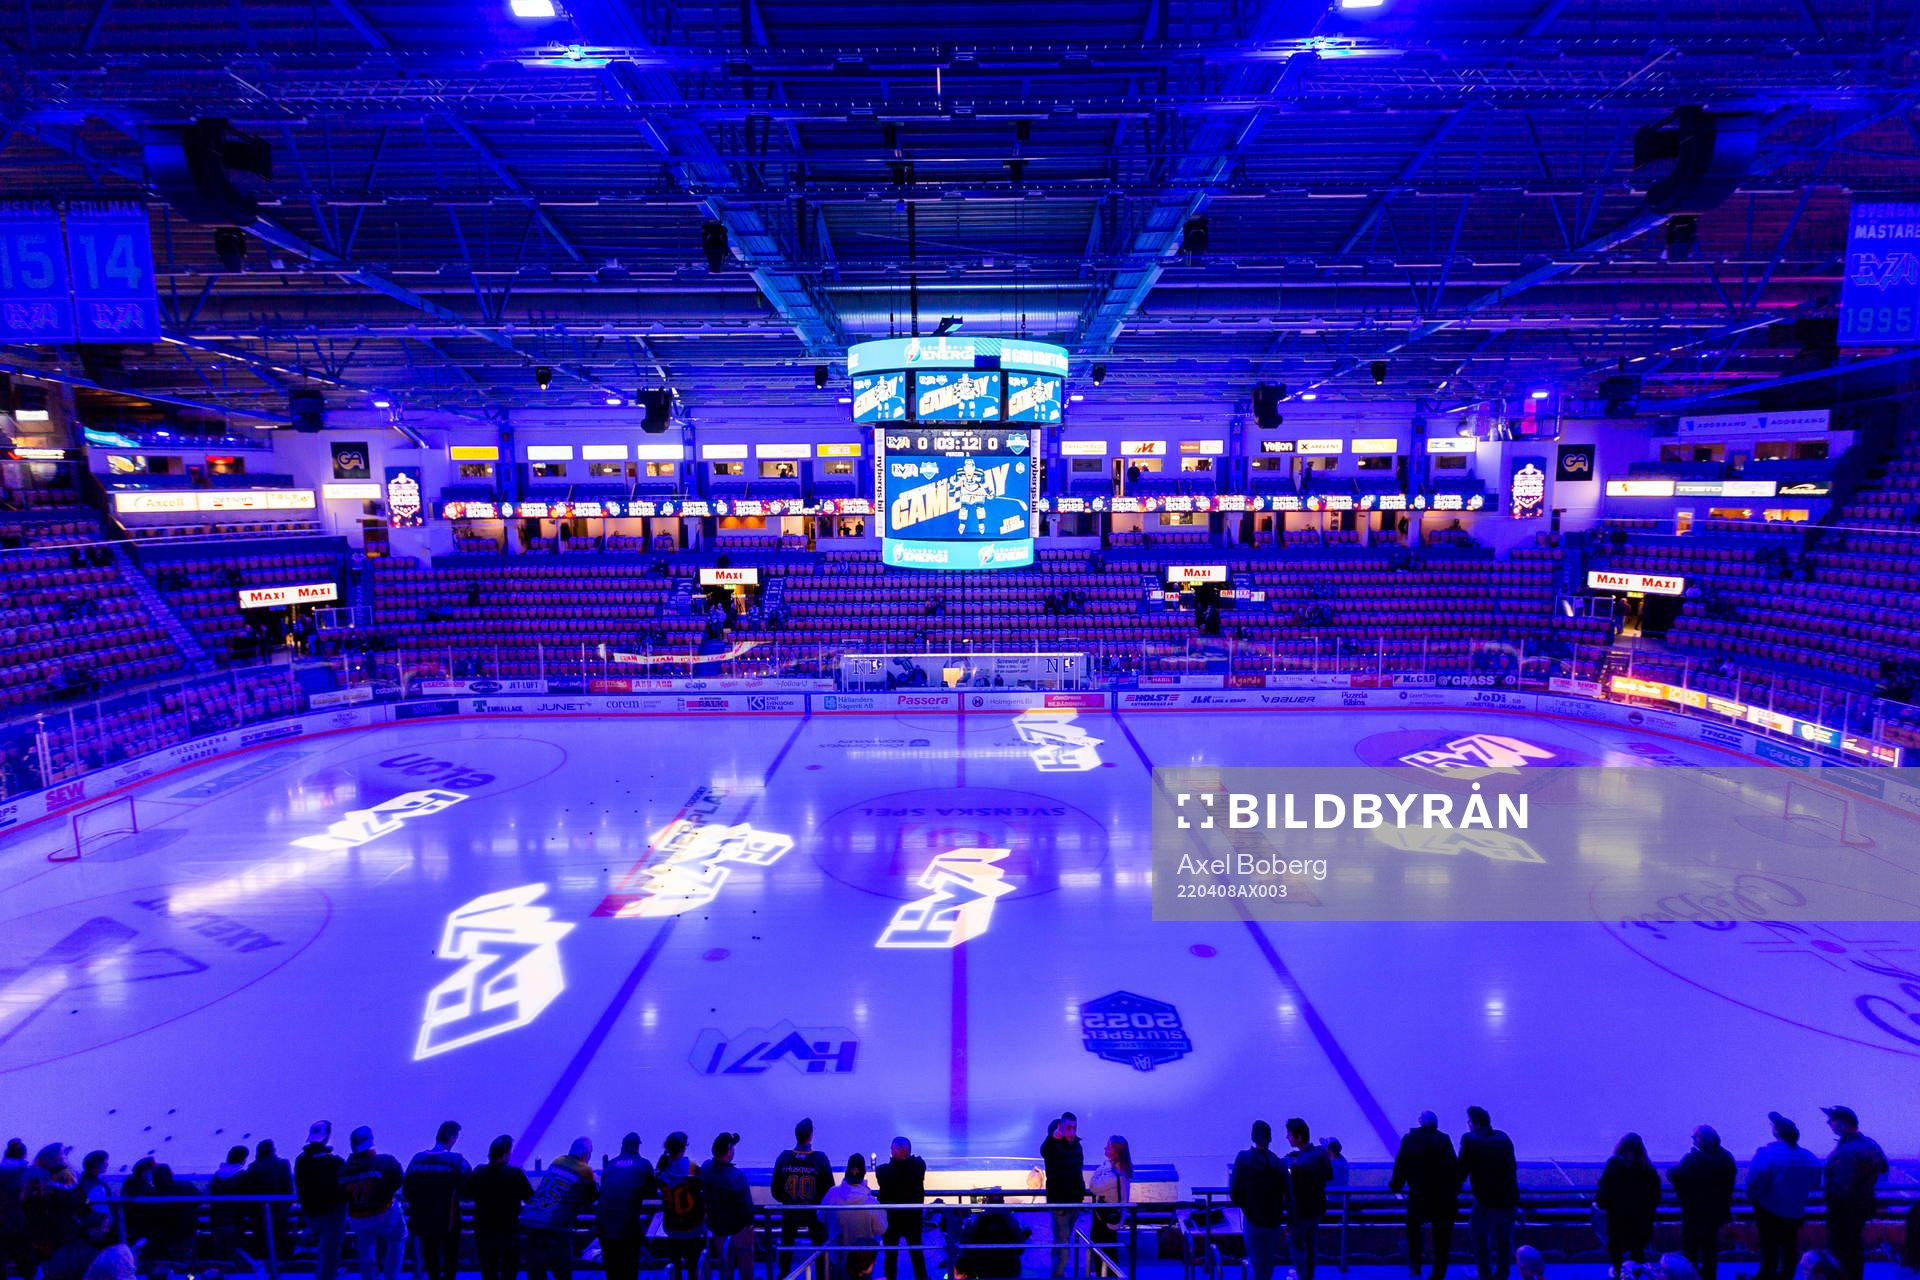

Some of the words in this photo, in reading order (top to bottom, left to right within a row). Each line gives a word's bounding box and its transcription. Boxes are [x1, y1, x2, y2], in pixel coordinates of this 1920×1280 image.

[69, 199, 142, 217] STILLMAN
[0, 234, 54, 289] 15
[79, 234, 142, 290] 14
[1847, 307, 1912, 333] 1995
[917, 438, 928, 449] 0
[937, 437, 979, 450] 03:12
[987, 438, 998, 449] 0
[891, 463, 1010, 531] GAMEAY
[1452, 675, 1495, 686] GRASS
[897, 694, 949, 706] Passera
[1134, 694, 1170, 702] HOLST
[1270, 696, 1316, 704] BAUER
[1474, 691, 1507, 703] JoDi
[537, 703, 585, 711] JUNET
[606, 700, 639, 709] corem
[1701, 729, 1742, 744] TROAX
[170, 735, 228, 757] HUSQVARNA
[46, 782, 85, 803] SEW
[860, 807, 926, 817] SPEL
[935, 807, 1066, 817] SVENSKA
[1083, 1012, 1179, 1028] 2022
[1085, 1029, 1184, 1040] SLUTSPEL
[704, 1030, 857, 1075] HV71
